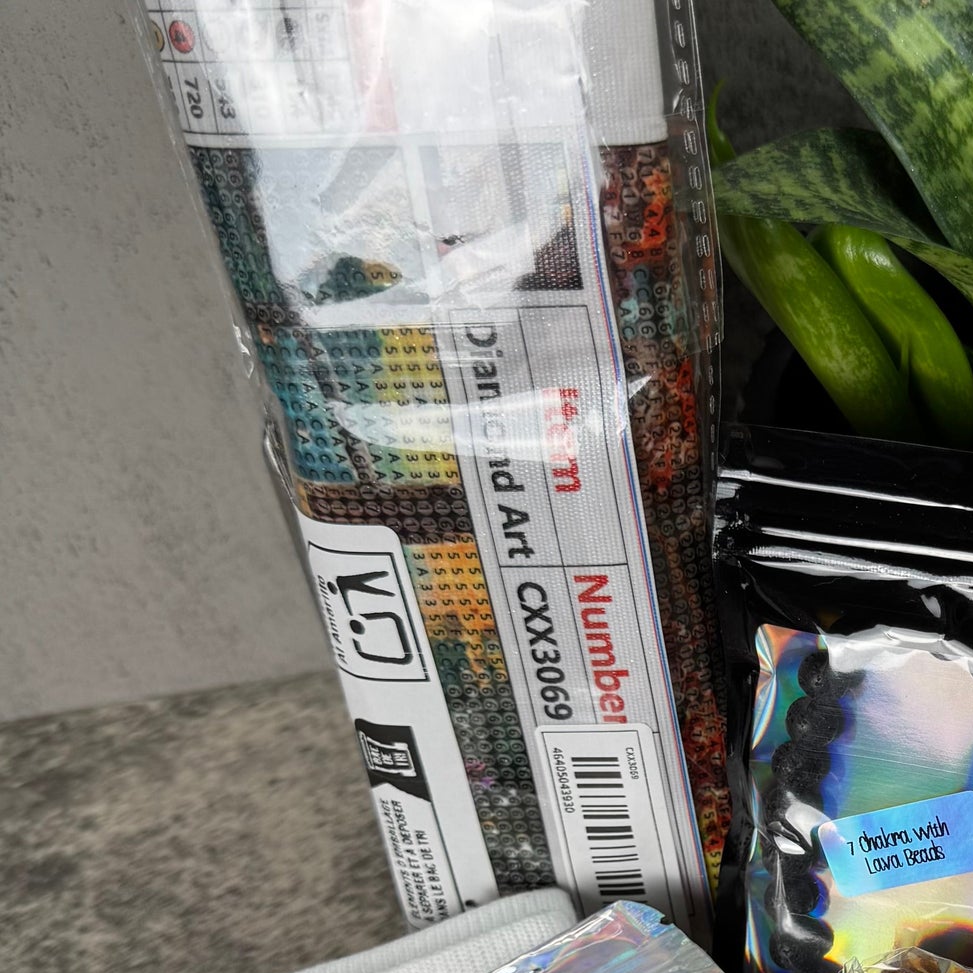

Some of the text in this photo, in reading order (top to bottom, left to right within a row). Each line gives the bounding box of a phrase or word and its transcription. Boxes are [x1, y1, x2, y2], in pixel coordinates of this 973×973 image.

[184, 76, 204, 119] 720
[497, 503, 535, 559] Art
[317, 574, 342, 645] Amarillo
[517, 581, 573, 721] CXX3069
[380, 751, 394, 766] DE
[393, 751, 409, 767] TRI
[625, 747, 639, 780] CXX3069
[552, 747, 575, 814] 46405043930
[846, 815, 950, 856] 7 Chakra with
[864, 840, 946, 875] Lava Beads
